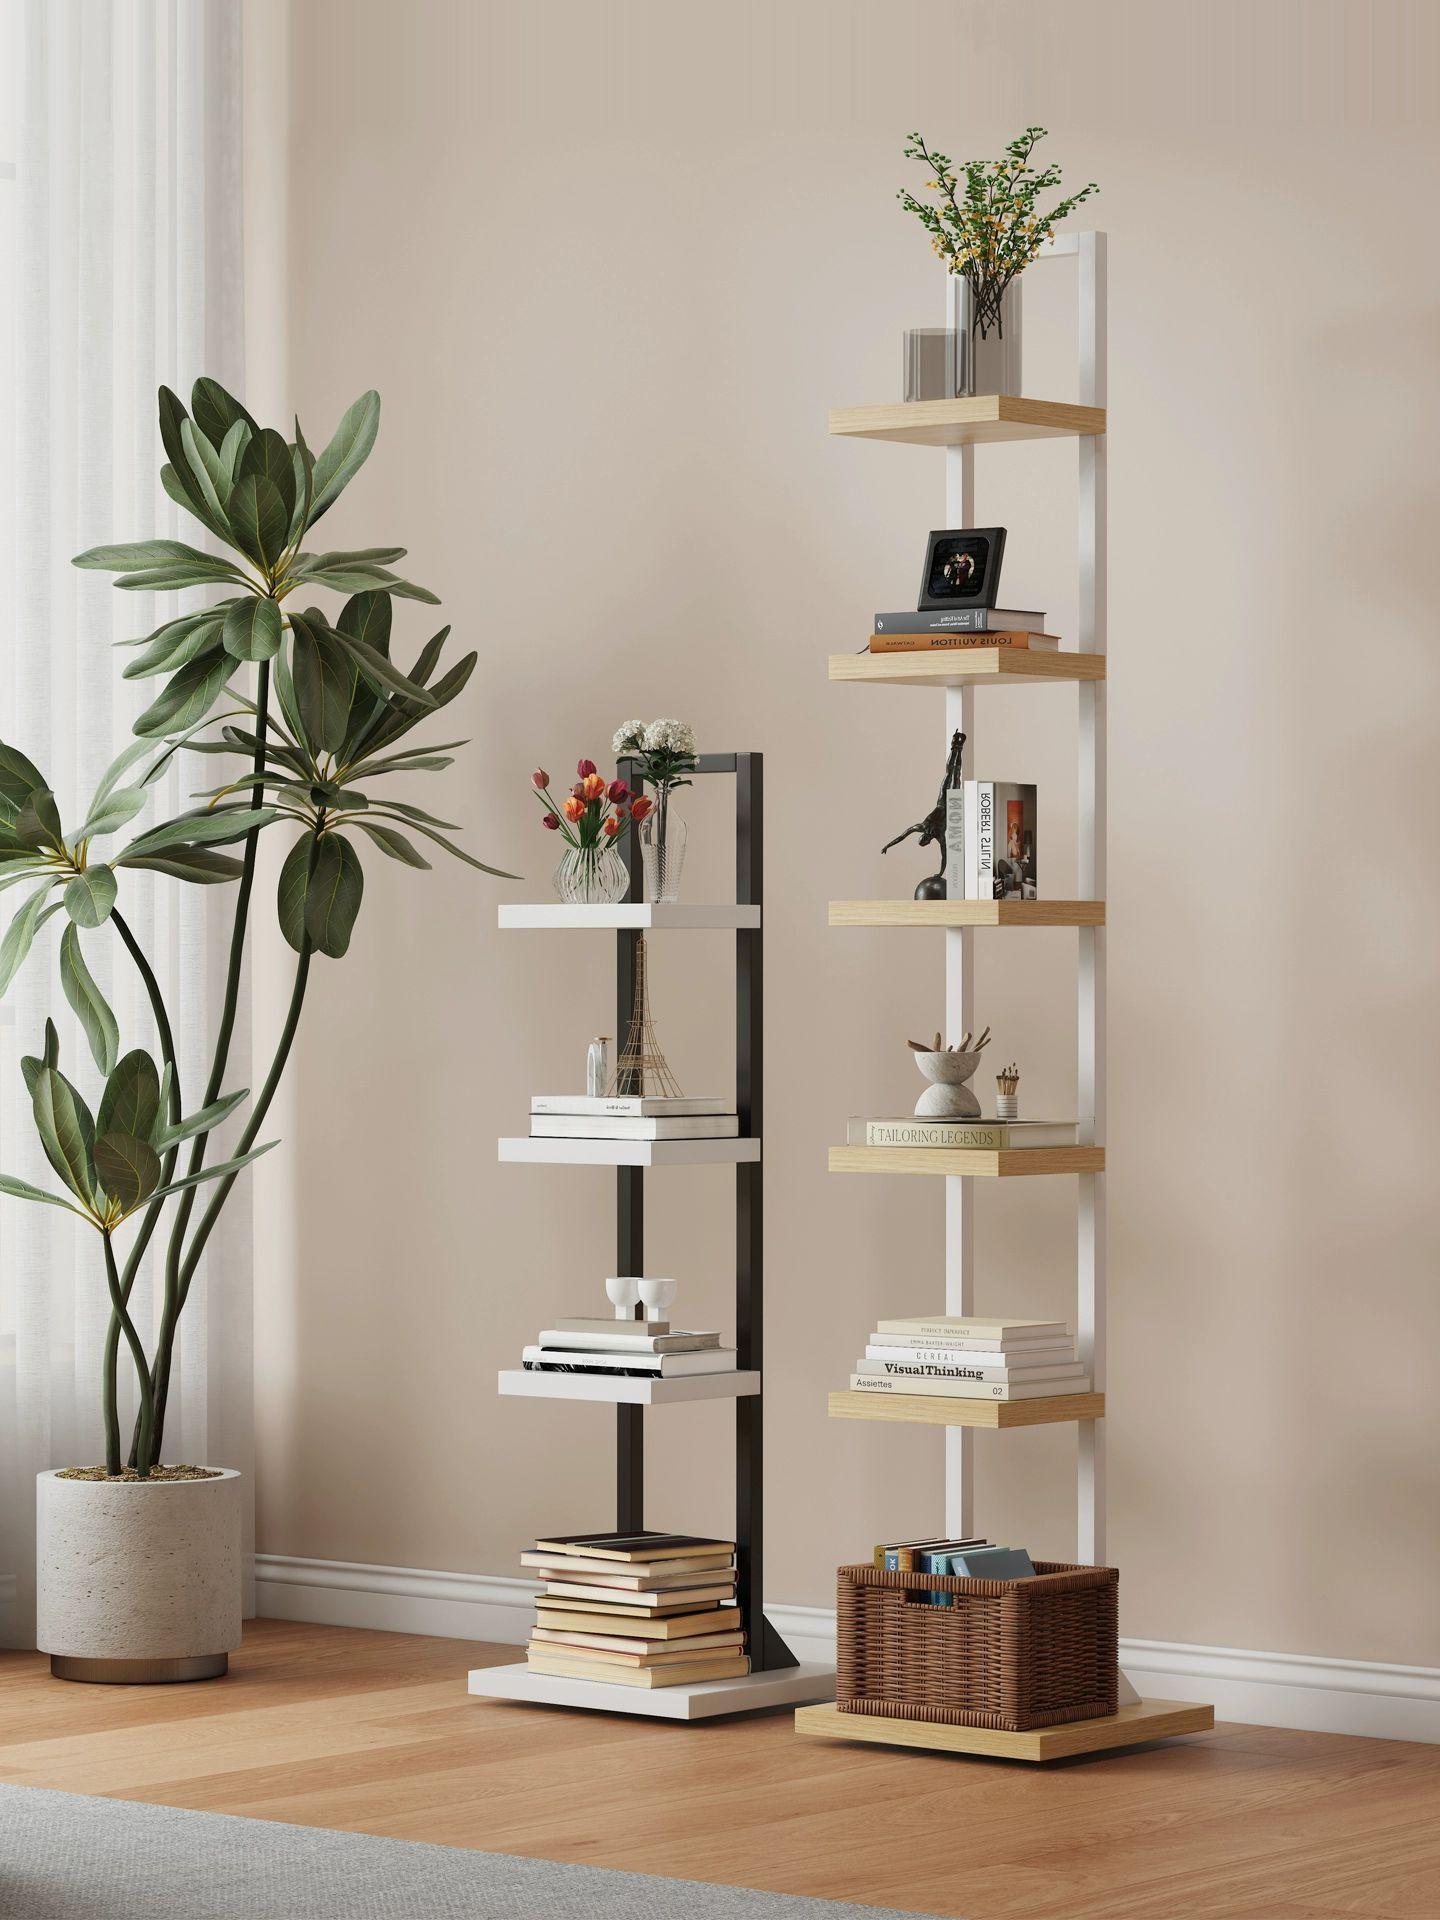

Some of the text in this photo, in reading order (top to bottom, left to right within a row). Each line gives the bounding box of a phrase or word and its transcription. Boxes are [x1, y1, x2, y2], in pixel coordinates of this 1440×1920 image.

[877, 1128, 938, 1143] TAILORING
[941, 1130, 993, 1145] LEGENDS
[916, 1352, 955, 1362] CEREAL
[856, 1379, 892, 1389] Assiettes
[992, 1387, 1003, 1395] 02
